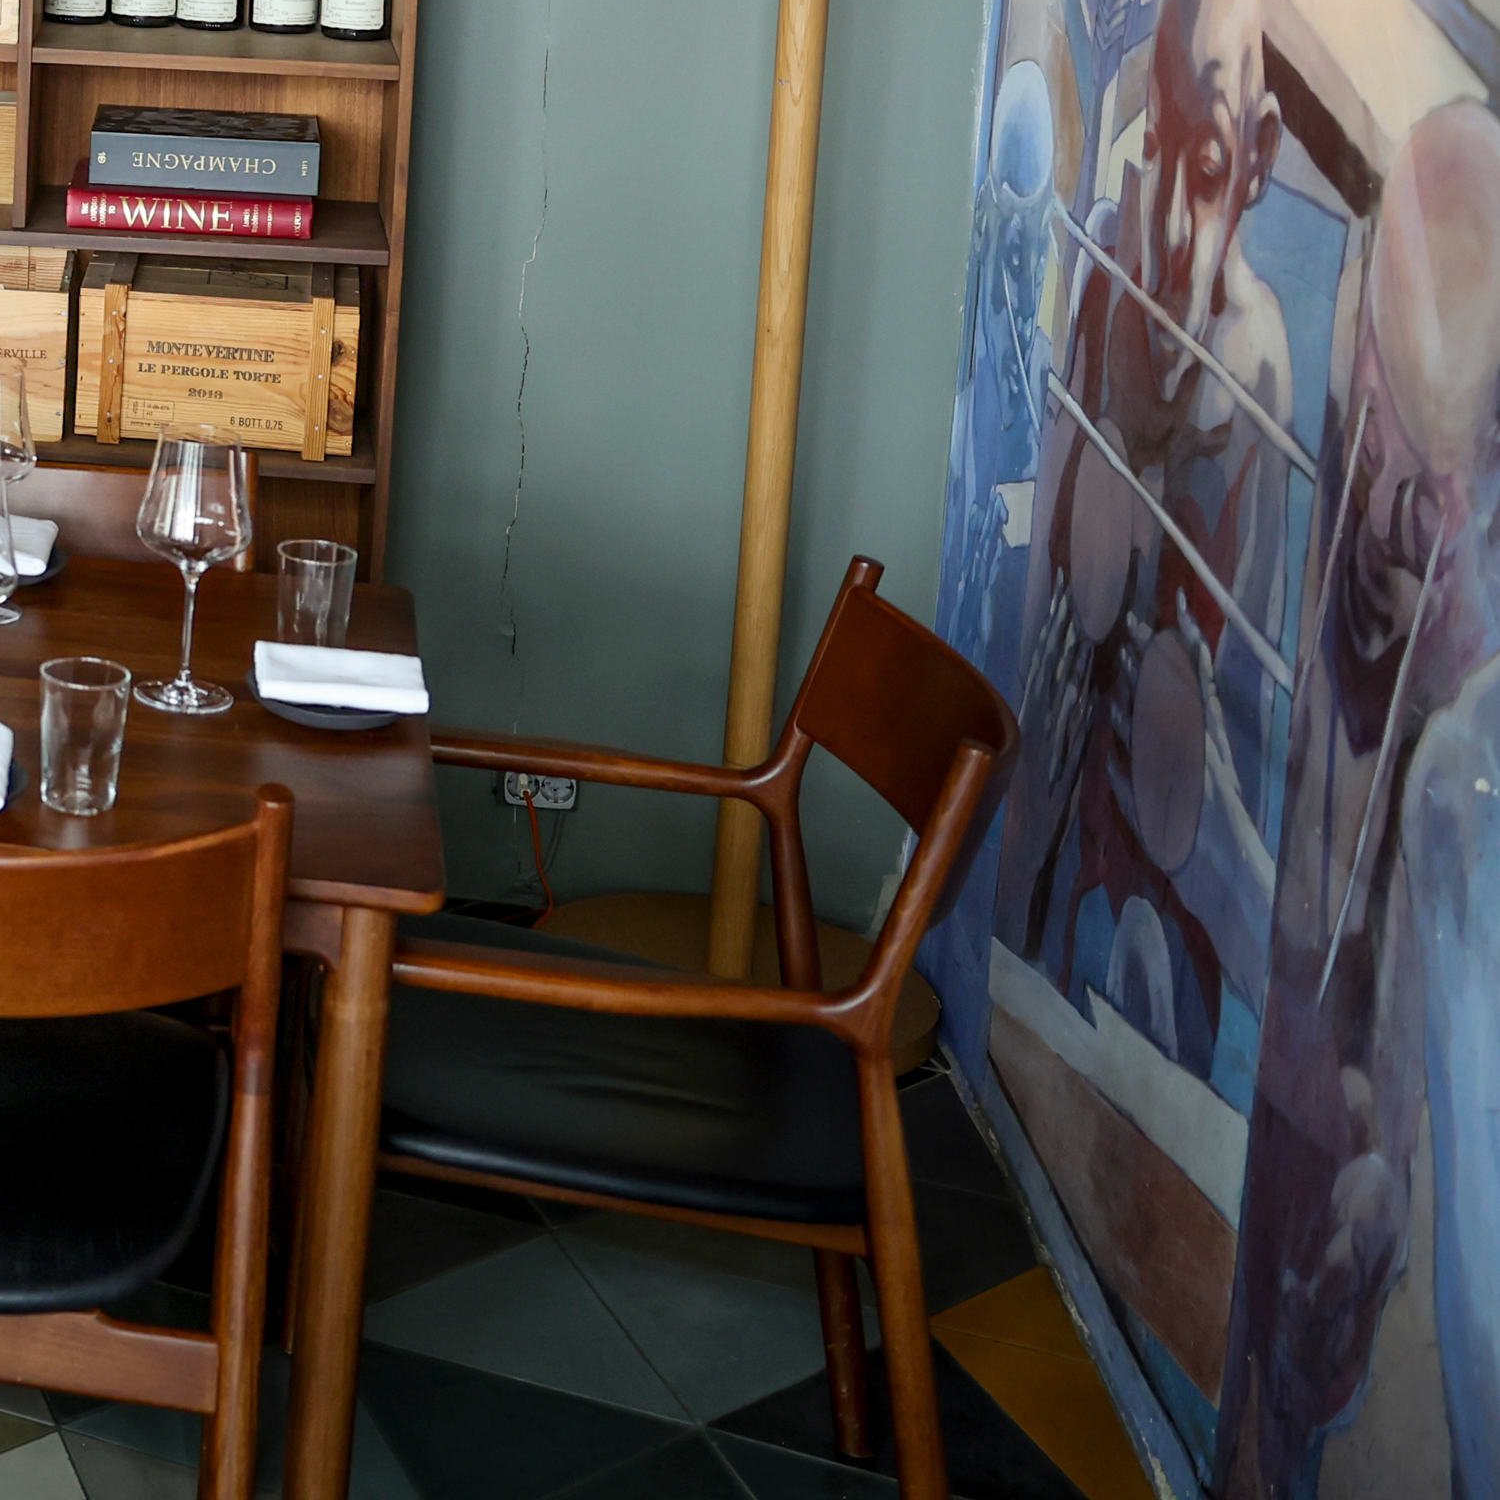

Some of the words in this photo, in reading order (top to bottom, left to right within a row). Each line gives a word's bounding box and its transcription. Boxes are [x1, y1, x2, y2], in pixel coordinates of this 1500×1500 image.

[132, 151, 277, 175] CHAMPAGNE
[109, 205, 116, 215] TO
[119, 195, 234, 233] WINE
[146, 340, 275, 363] MONTEVERTINE
[137, 362, 157, 374] LE
[161, 364, 229, 380] PERGOLE
[233, 369, 282, 384] TORTE
[229, 416, 236, 426] 6
